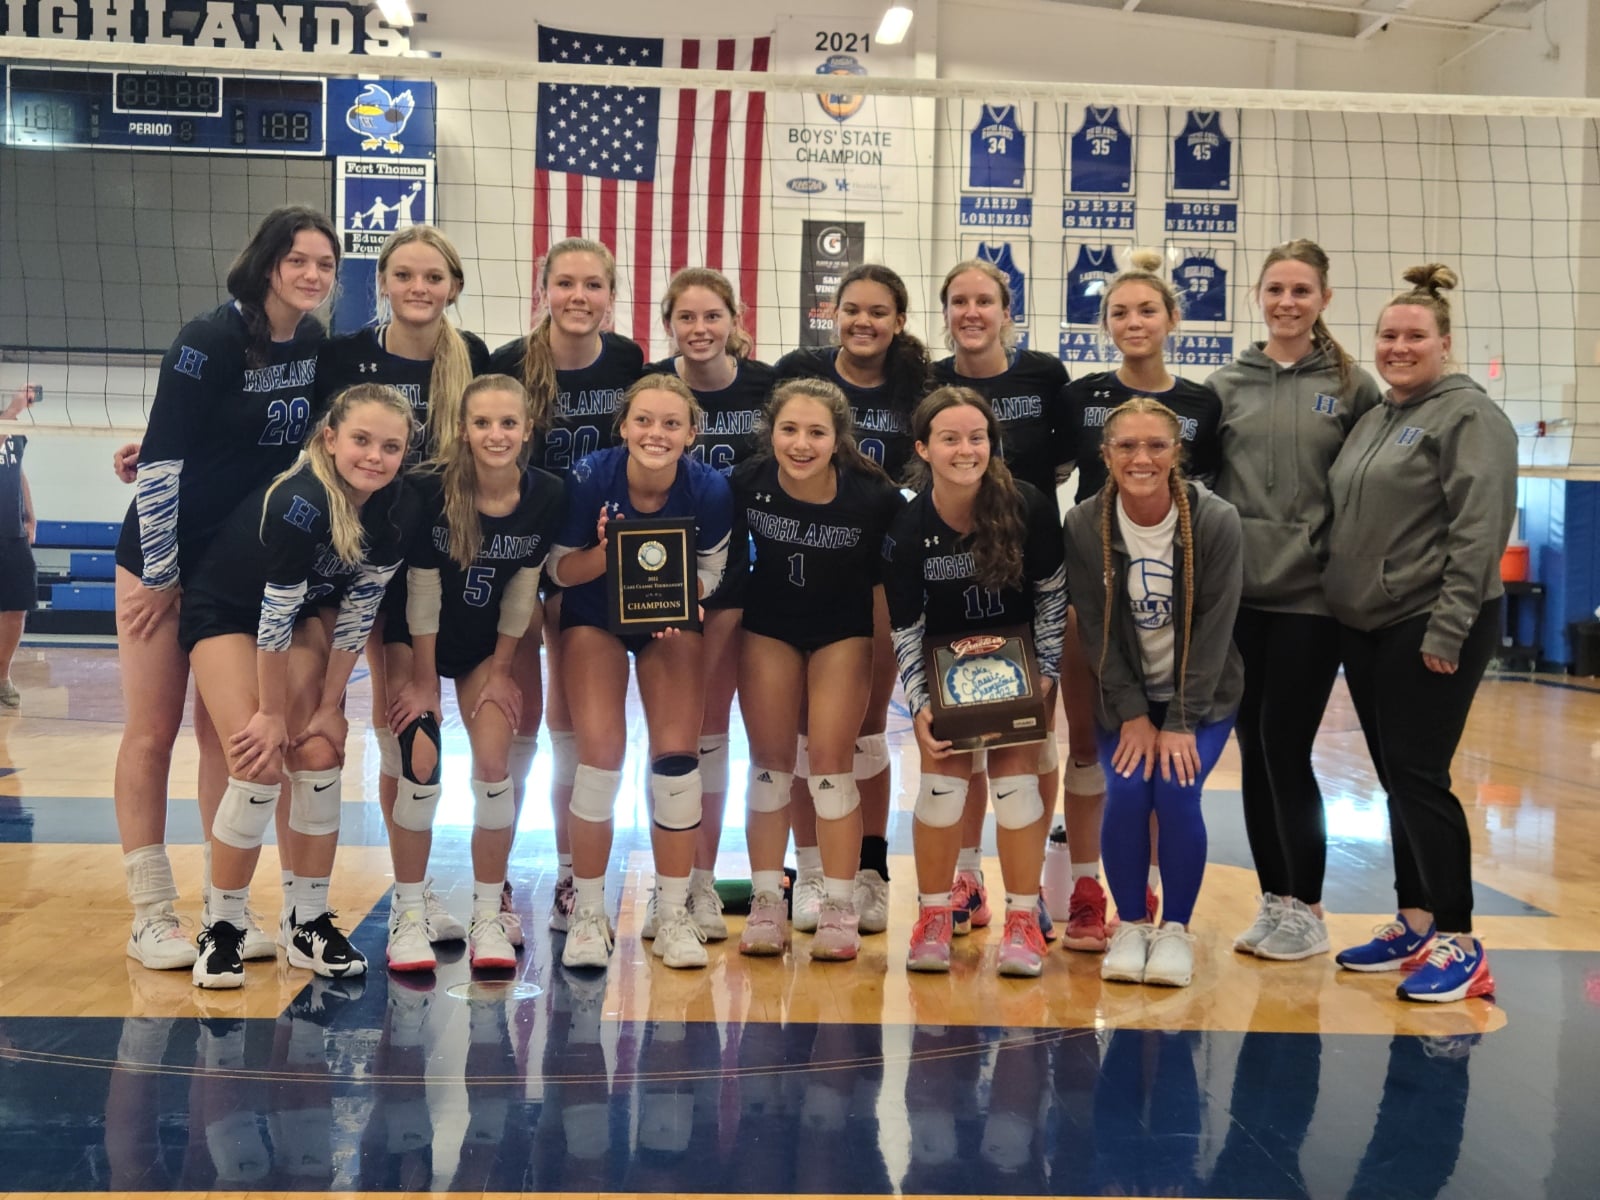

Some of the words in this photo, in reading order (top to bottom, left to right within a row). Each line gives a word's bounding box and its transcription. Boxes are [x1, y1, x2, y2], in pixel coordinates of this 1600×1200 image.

[815, 32, 870, 53] 2021
[129, 123, 172, 136] PERIOD
[788, 128, 838, 145] BOYS'
[842, 130, 892, 147] STATE
[987, 137, 1006, 154] 34
[1091, 139, 1110, 155] 35
[1193, 144, 1211, 160] 45
[796, 147, 883, 165] CHAMPION
[346, 162, 374, 173] Fort
[376, 163, 424, 175] Thomas
[974, 197, 1018, 209] JARED
[1064, 200, 1133, 213] DEREK
[1182, 204, 1220, 216] ROSS
[961, 212, 1031, 225] LORENZEN
[1065, 215, 1132, 228] SMITH
[1166, 219, 1235, 231] NELTNER
[174, 345, 208, 380] H
[1312, 392, 1338, 417] H
[258, 397, 310, 445] 28
[1395, 426, 1424, 446] H
[545, 425, 599, 469] 20
[283, 494, 321, 533] H
[747, 508, 862, 549] HIGHLANDS
[788, 553, 805, 587] 1
[463, 566, 496, 607] 5
[627, 600, 681, 610] CHAMPIONS
[963, 585, 1005, 619] 11
